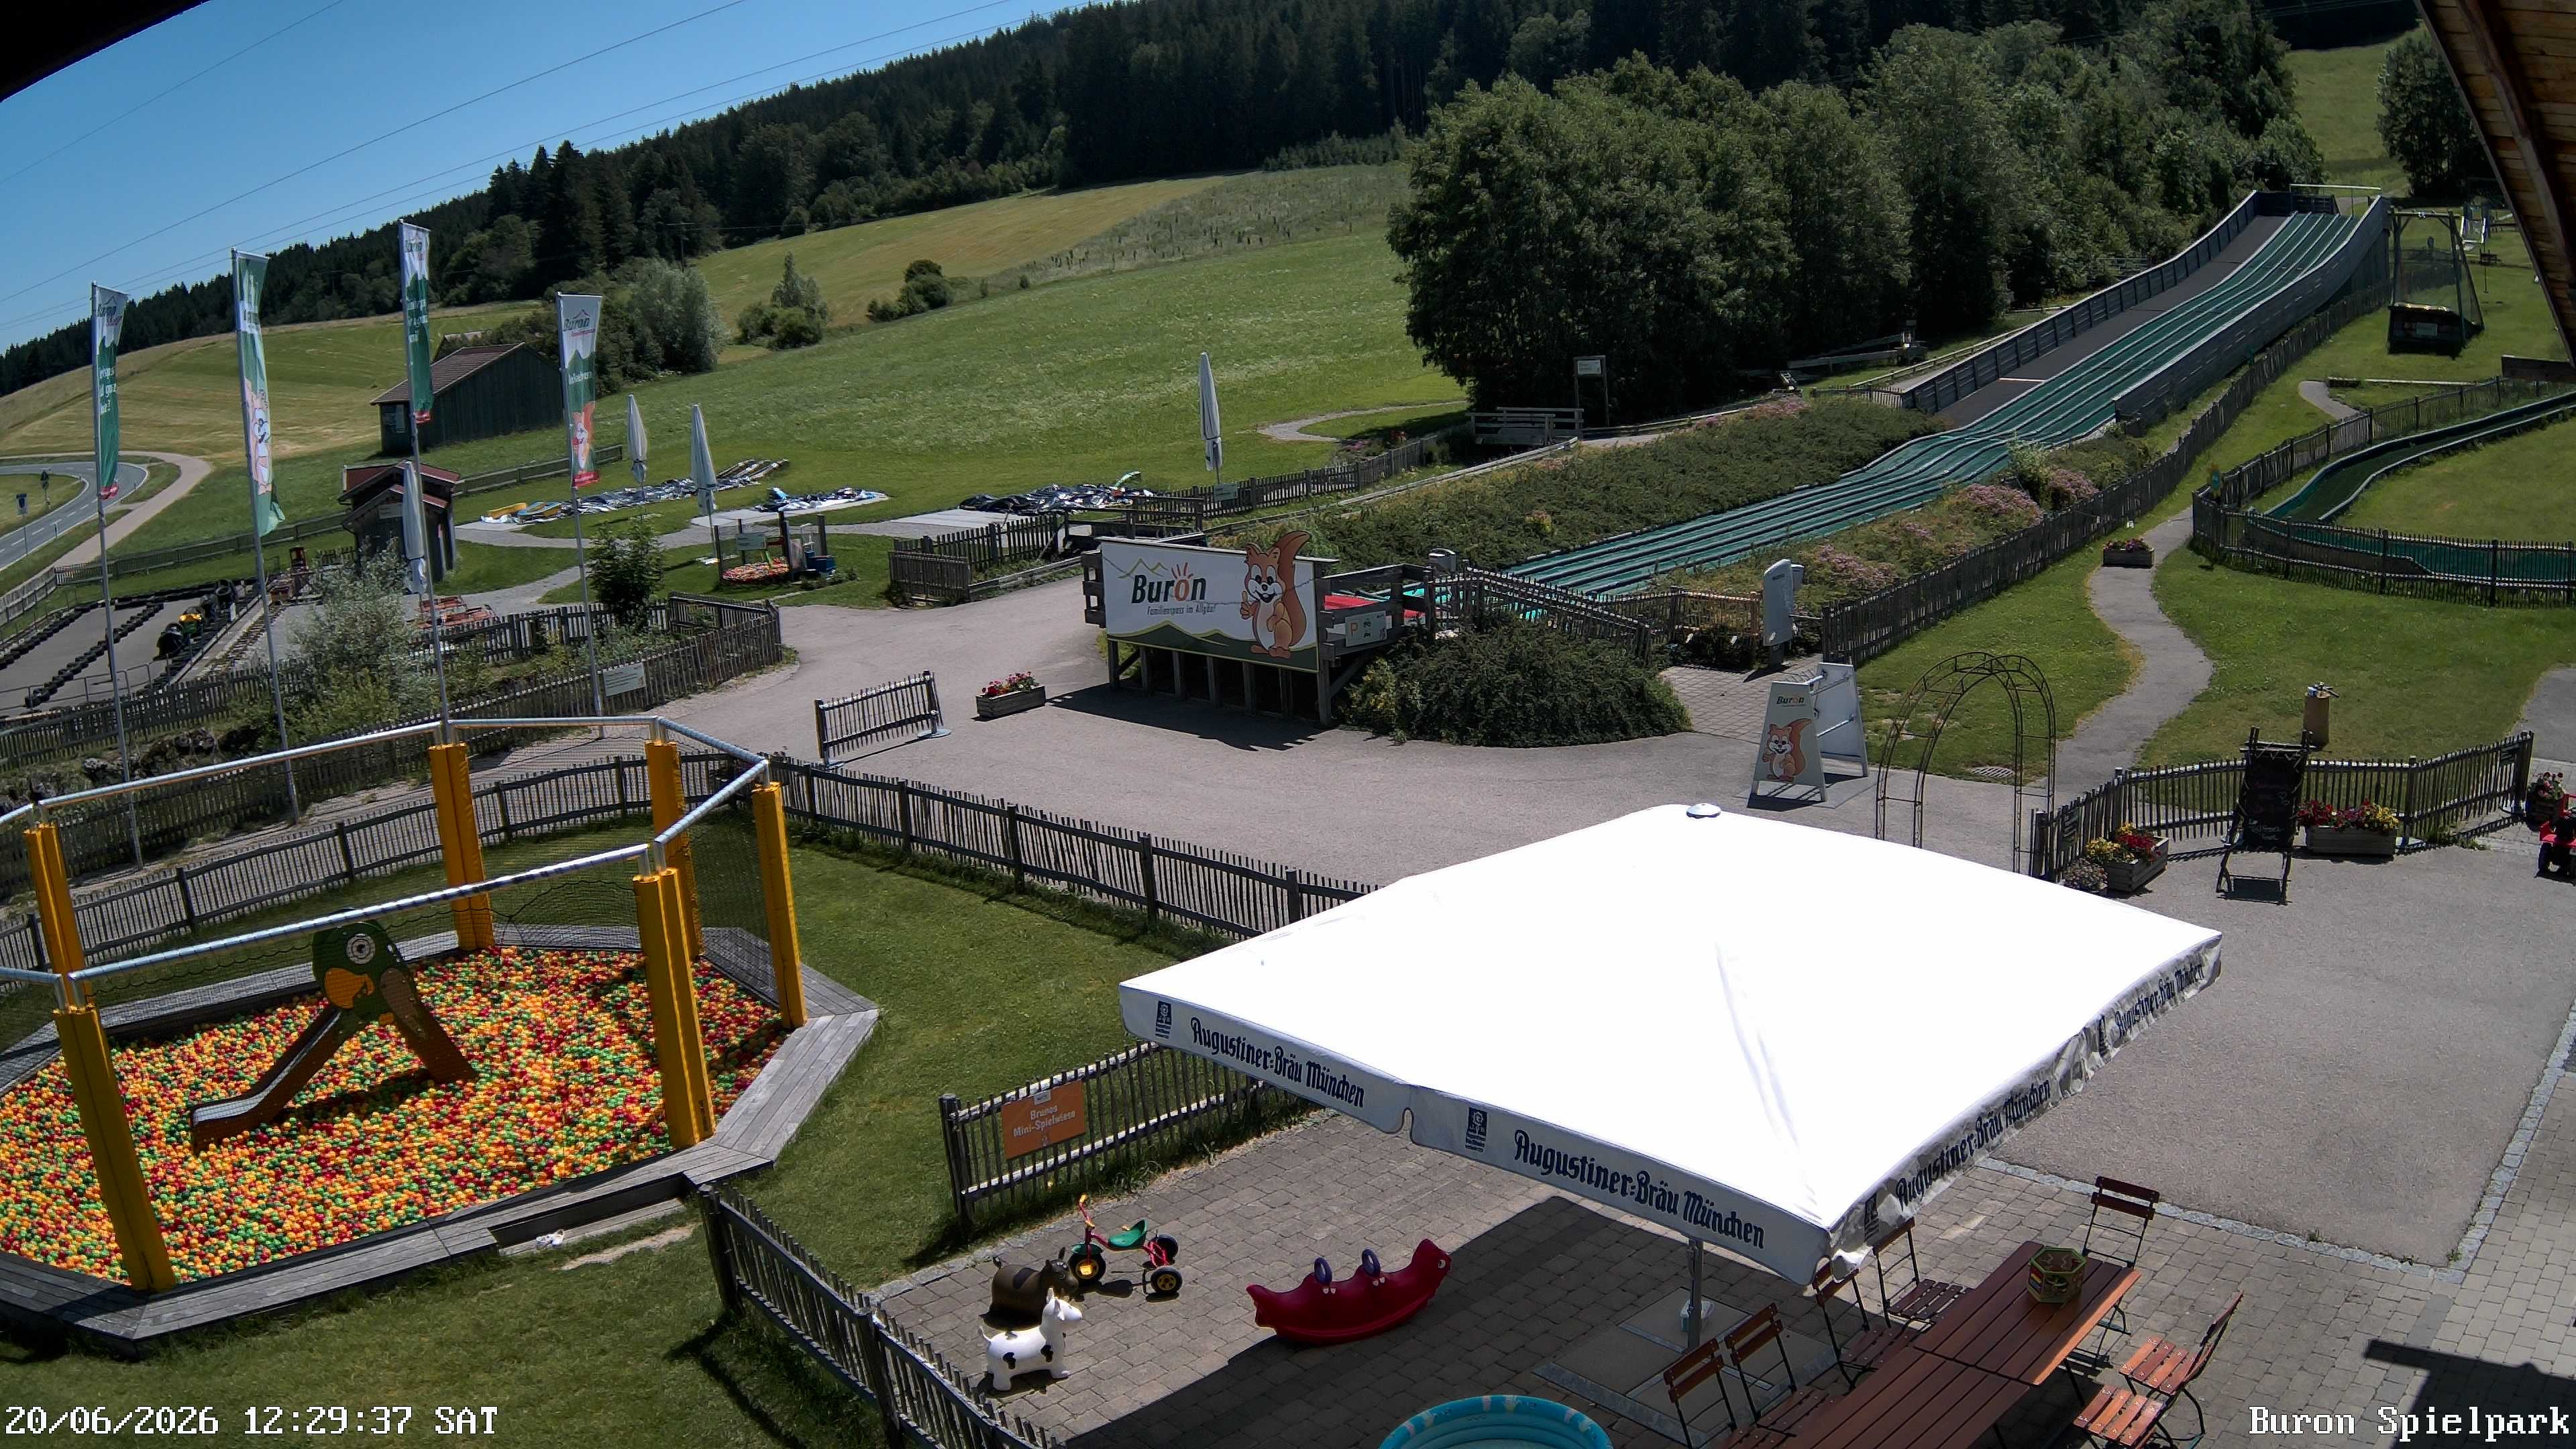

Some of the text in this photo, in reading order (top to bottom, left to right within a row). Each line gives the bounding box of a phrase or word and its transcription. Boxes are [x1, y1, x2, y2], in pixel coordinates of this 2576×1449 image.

[1131, 574, 1207, 604] Buron
[1776, 696, 1805, 704] Buron
[1305, 1060, 1364, 1108] München
[2004, 1079, 2051, 1128] München
[1682, 1190, 1764, 1248] München
